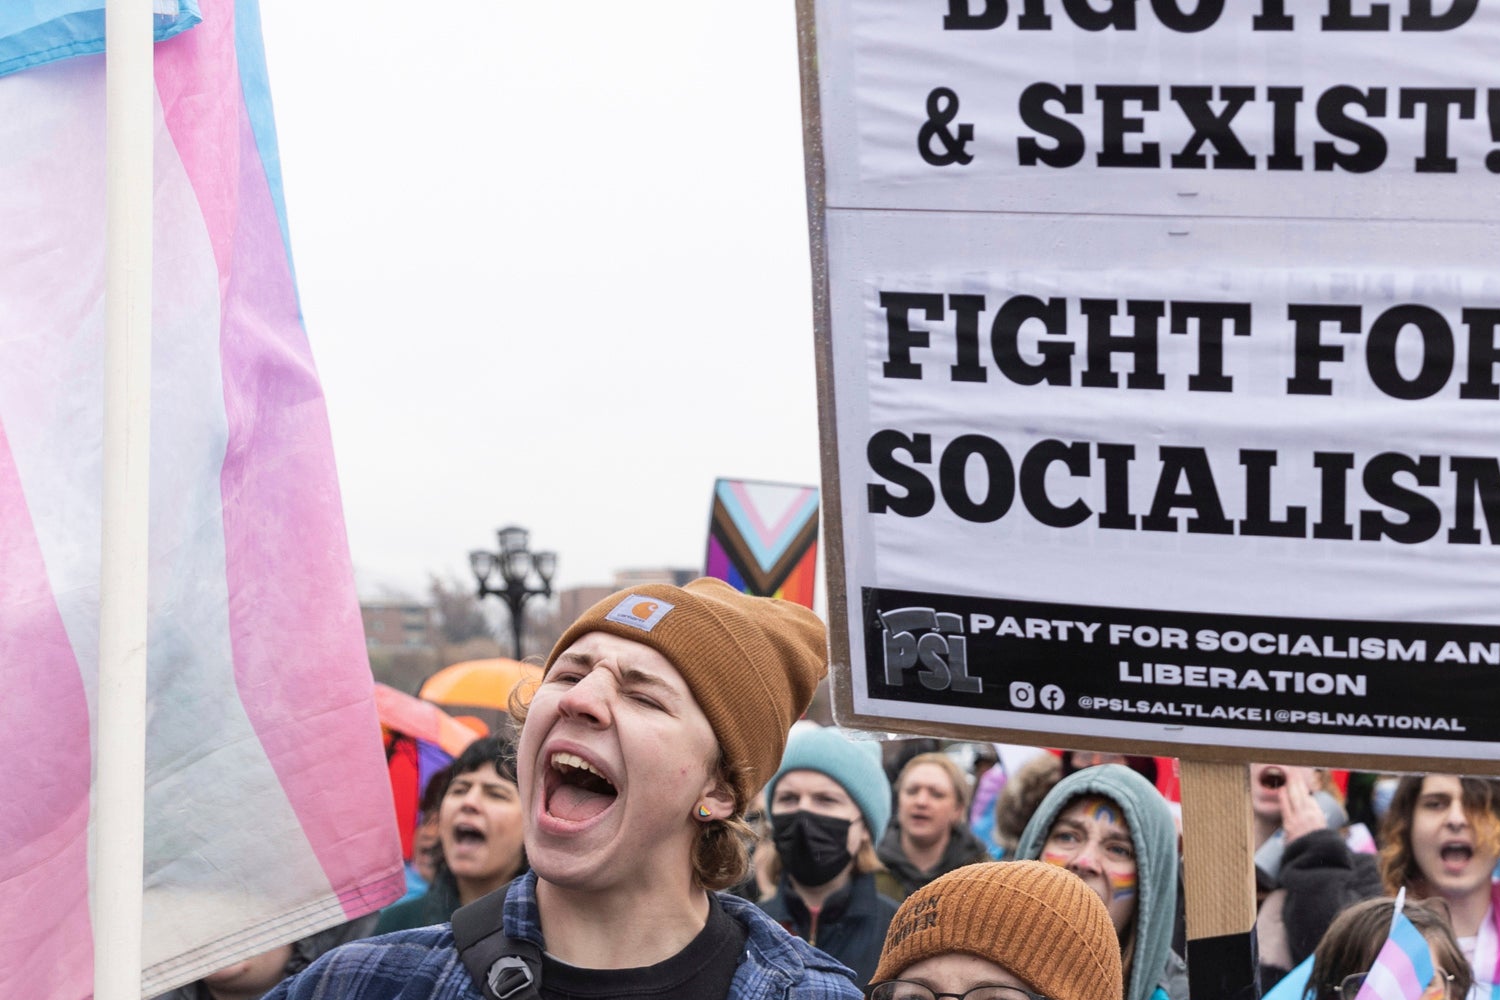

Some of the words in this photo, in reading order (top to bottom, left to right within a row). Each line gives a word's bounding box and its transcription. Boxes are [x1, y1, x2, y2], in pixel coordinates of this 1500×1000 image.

[917, 86, 974, 168] &
[878, 291, 1252, 393] FIGHT
[882, 630, 983, 694] PSL
[969, 613, 1101, 643] PARTY
[1109, 624, 1188, 650] FOR
[1195, 629, 1427, 662] SOCIALISM
[1118, 661, 1367, 696] LIBERATION
